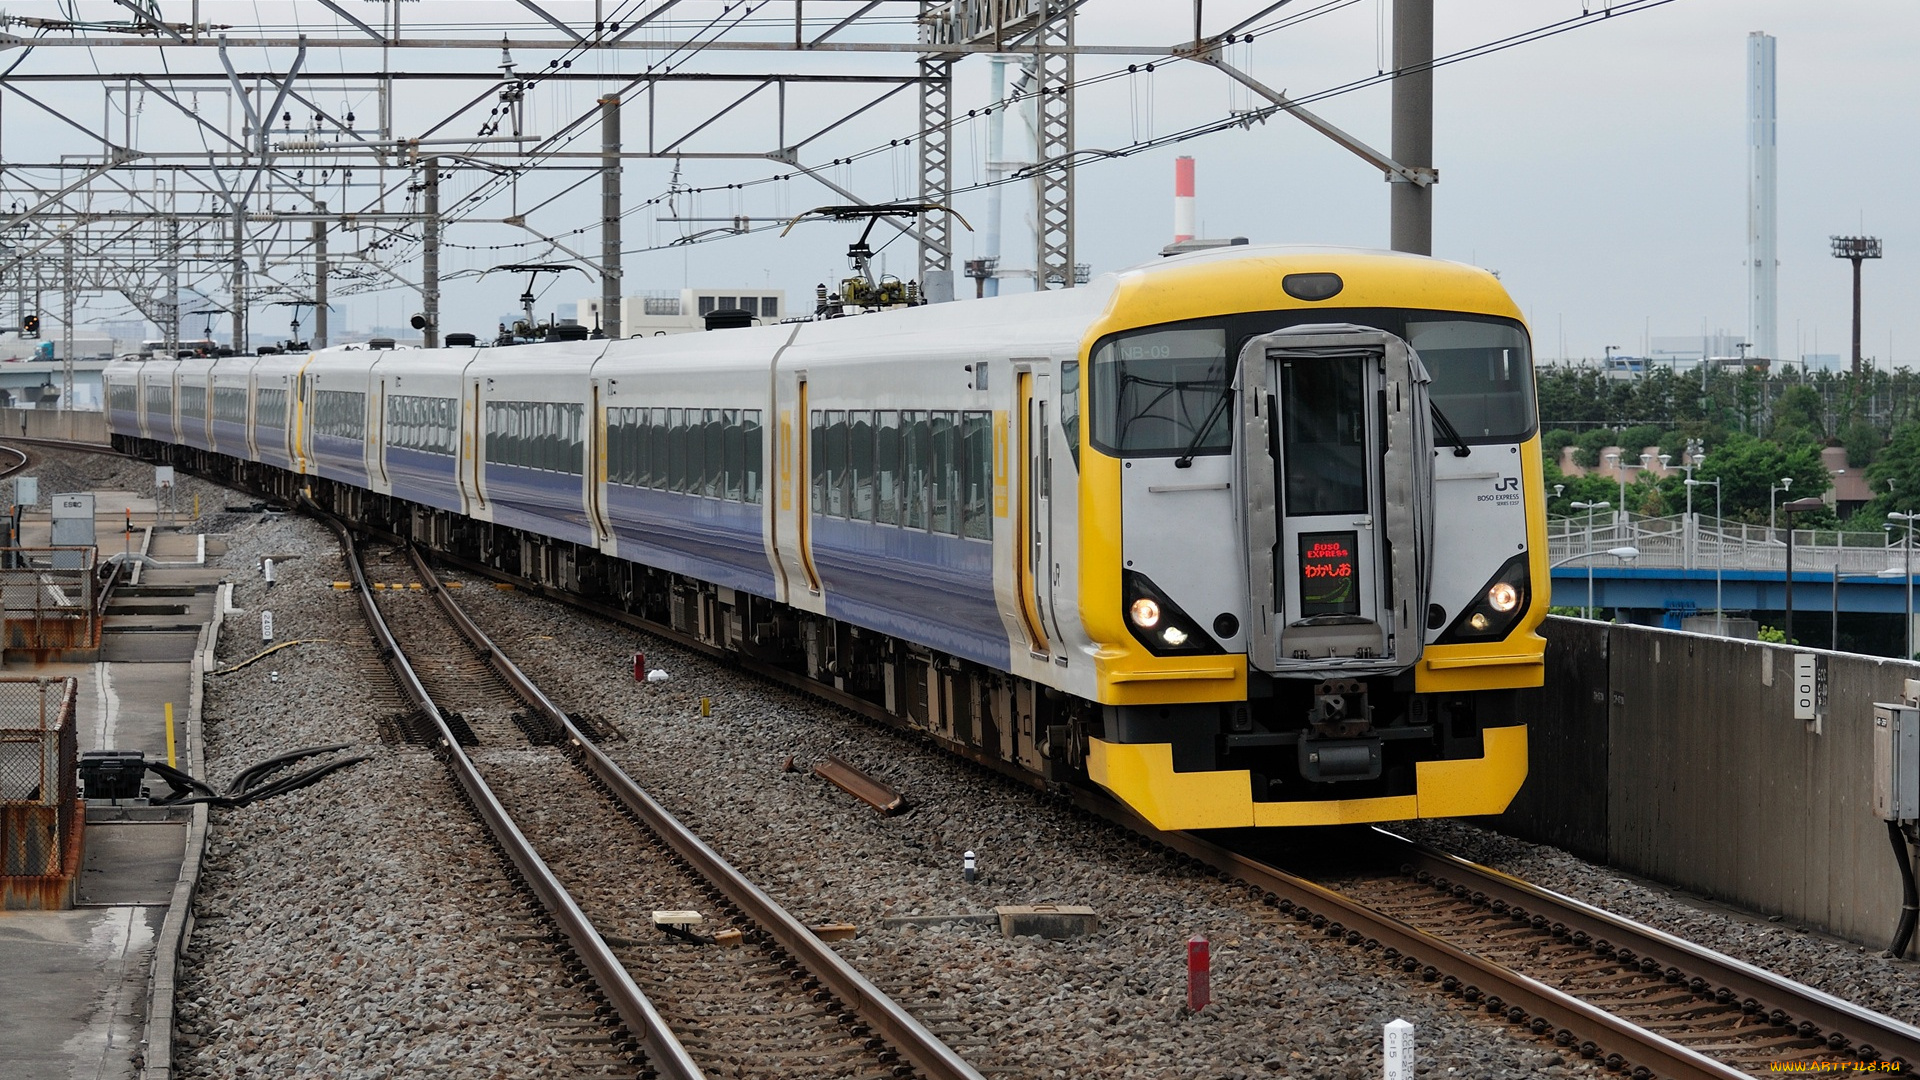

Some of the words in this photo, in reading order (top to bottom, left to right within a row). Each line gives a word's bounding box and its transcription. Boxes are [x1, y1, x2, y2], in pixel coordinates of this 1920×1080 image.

[1120, 345, 1170, 360] NB-09
[1495, 477, 1519, 491] JR
[1477, 494, 1495, 502] BOSO
[1495, 493, 1520, 501] EXPRESS
[1307, 549, 1348, 558] EXPRESS
[1304, 563, 1352, 578] わかしお
[263, 614, 271, 637] 2400
